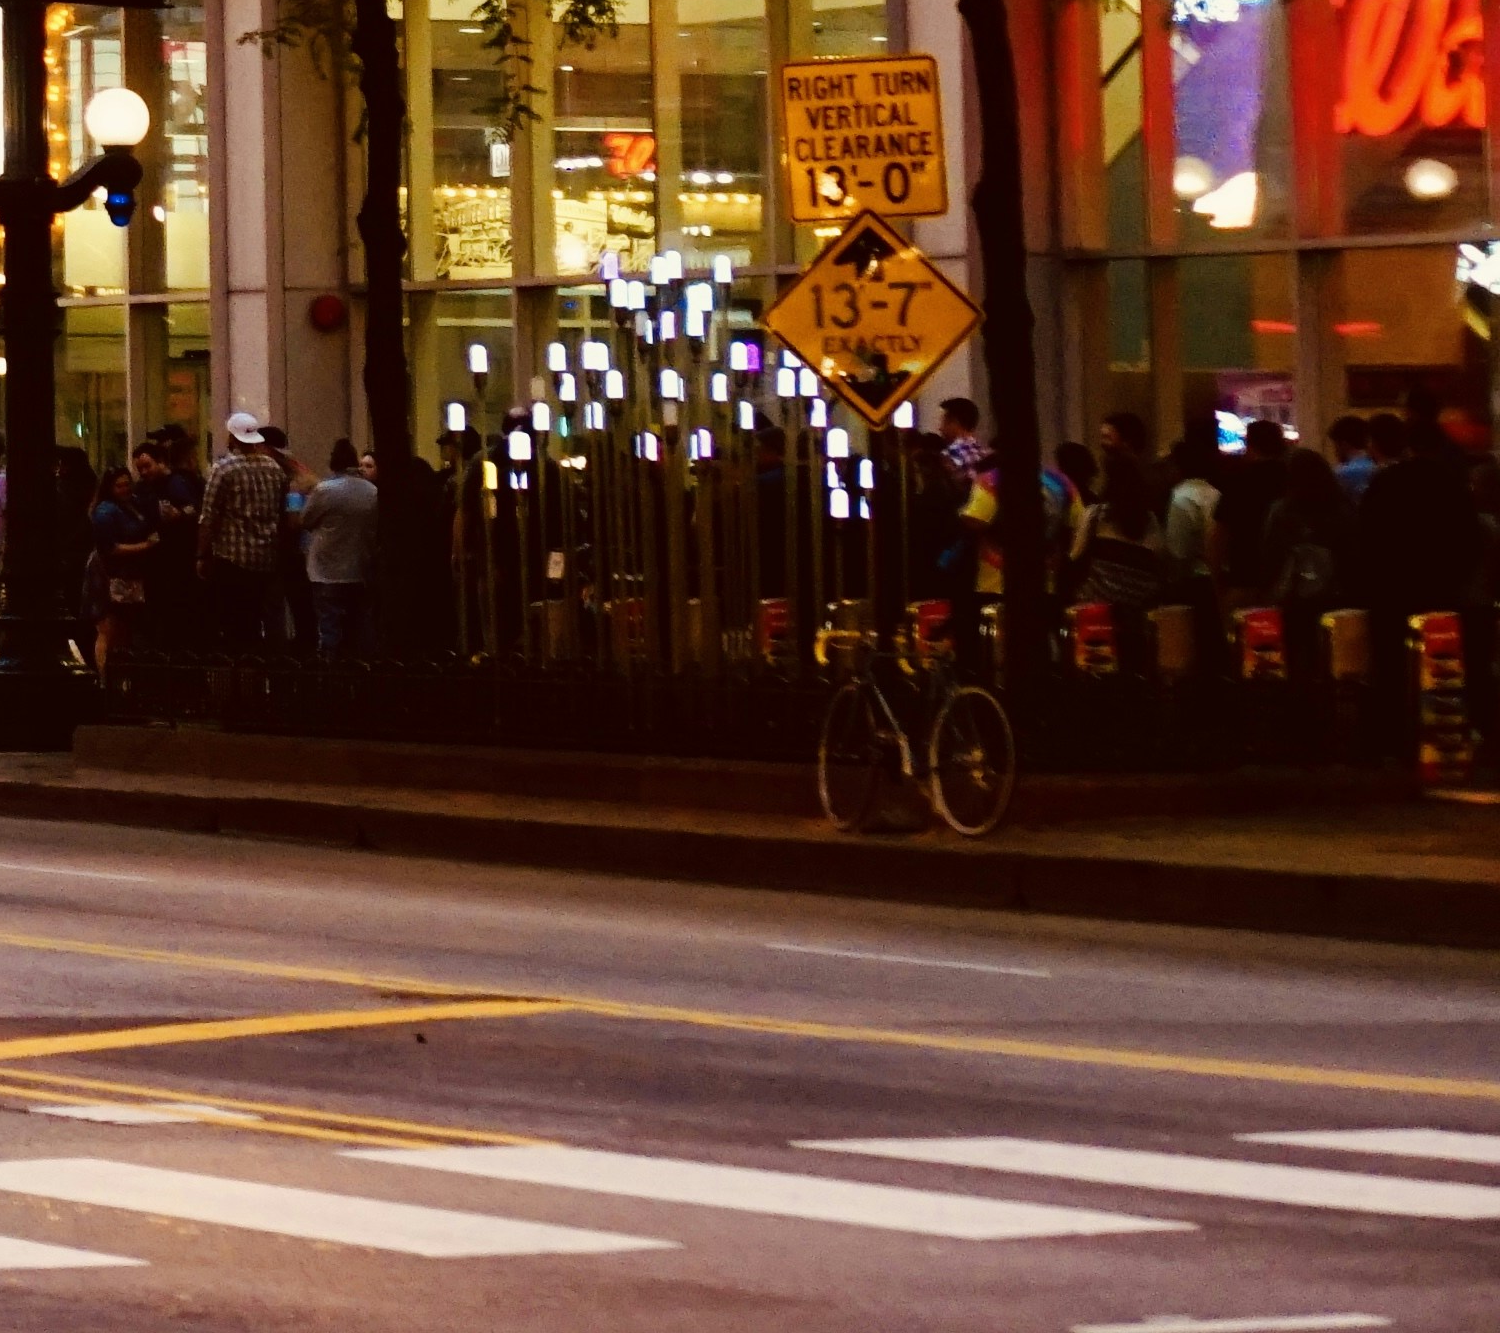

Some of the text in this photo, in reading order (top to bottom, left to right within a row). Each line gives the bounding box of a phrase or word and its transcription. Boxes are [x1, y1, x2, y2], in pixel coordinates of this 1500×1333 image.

[788, 71, 931, 101] RIGHT TURN
[805, 101, 917, 130] VERTICAL
[794, 132, 934, 162] CLEARANCE
[822, 334, 922, 355] EXACTLY
